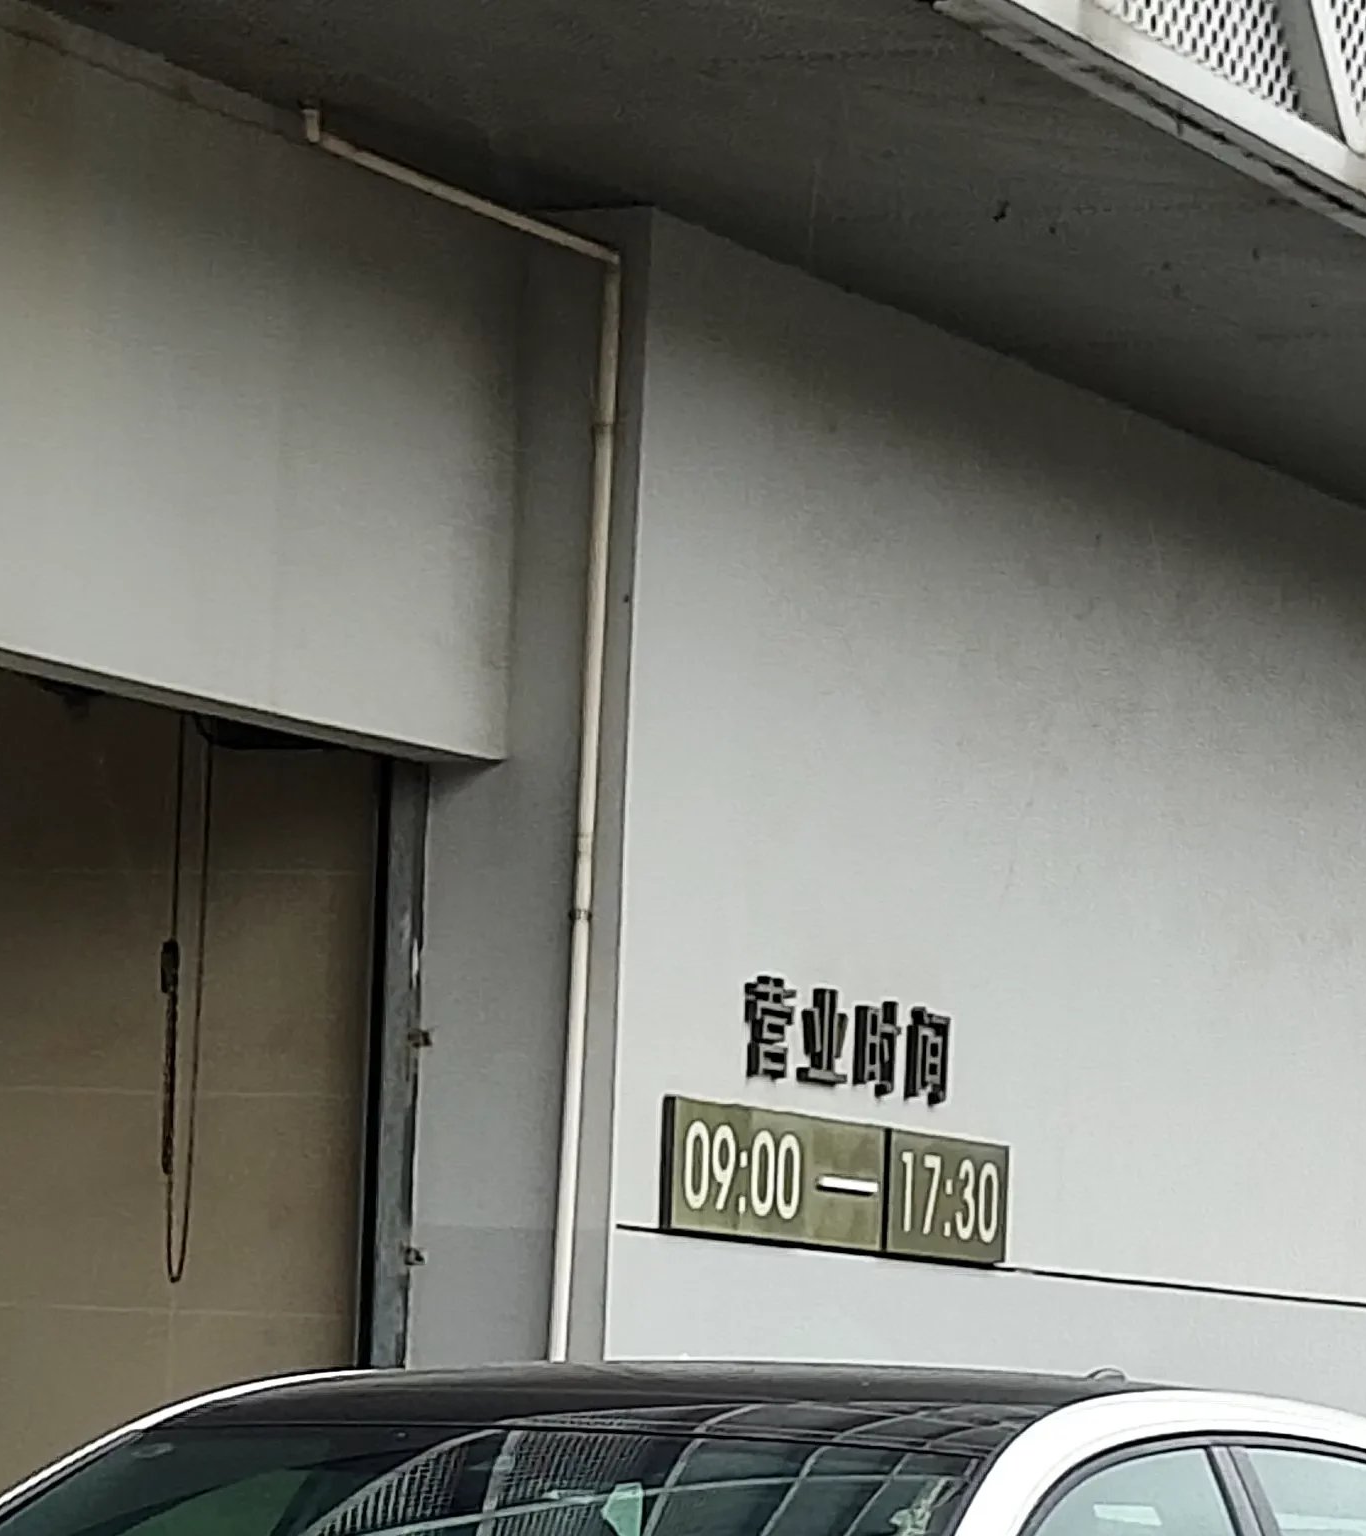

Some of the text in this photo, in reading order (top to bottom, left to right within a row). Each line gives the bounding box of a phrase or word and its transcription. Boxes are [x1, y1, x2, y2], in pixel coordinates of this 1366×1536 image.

[744, 975, 951, 1106] 营业时间
[684, 1120, 803, 1220] 09:00
[902, 1151, 1001, 1245] 17:30
